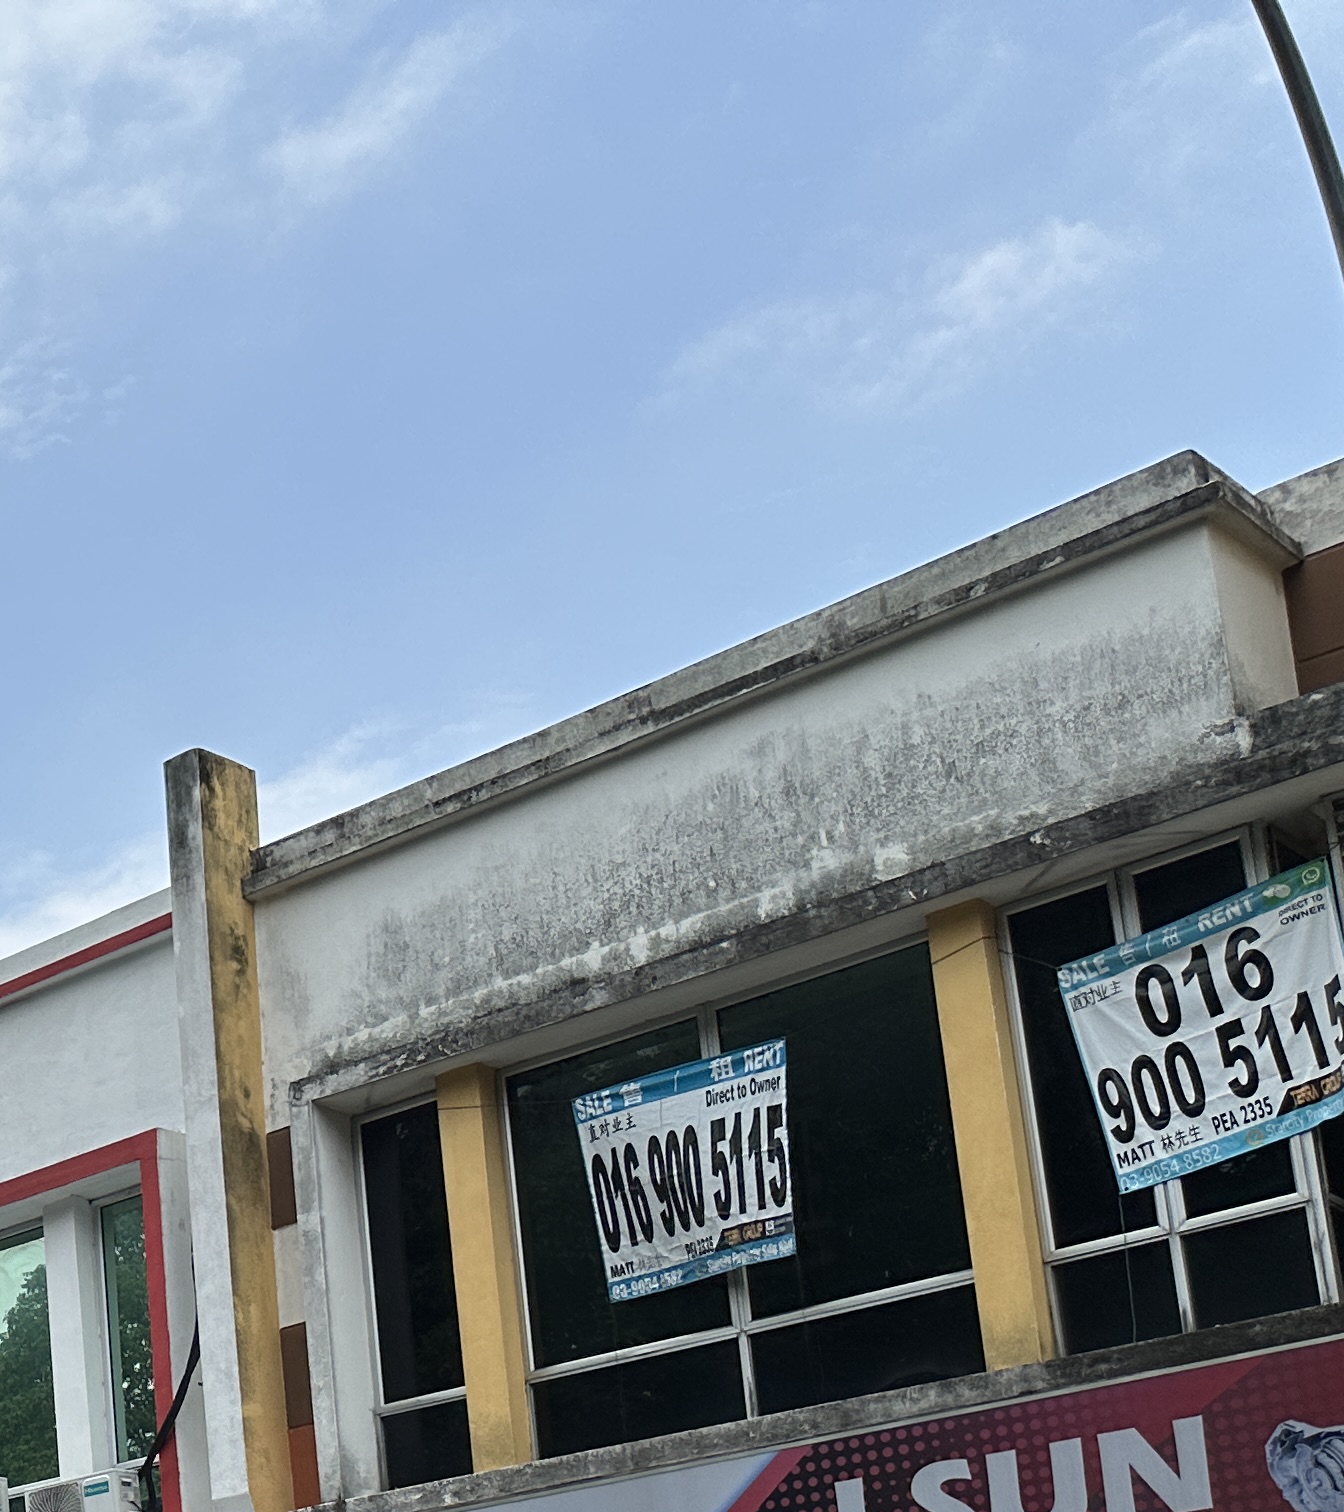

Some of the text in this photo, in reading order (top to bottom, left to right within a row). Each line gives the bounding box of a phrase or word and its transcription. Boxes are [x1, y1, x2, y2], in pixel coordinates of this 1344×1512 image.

[1278, 893, 1323, 917] DIRECT TO
[1280, 903, 1326, 925] OWNER
[1057, 954, 1111, 989] SALE
[1198, 894, 1256, 932] RENT
[1135, 926, 1274, 1037] 016
[575, 1090, 612, 1120] SALE
[743, 1040, 785, 1073] RENT
[1097, 973, 1344, 1144] 900 5115
[705, 1075, 781, 1107] Direct to Owner
[588, 1112, 637, 1143] 直对业主
[1116, 1140, 1155, 1169] MATT
[1211, 1114, 1239, 1135] PEA
[1240, 1096, 1273, 1124] 2335
[591, 1103, 788, 1253] 016 900 5115
[1120, 1143, 1222, 1191] 03-9054 8582
[610, 1261, 635, 1279] MATT
